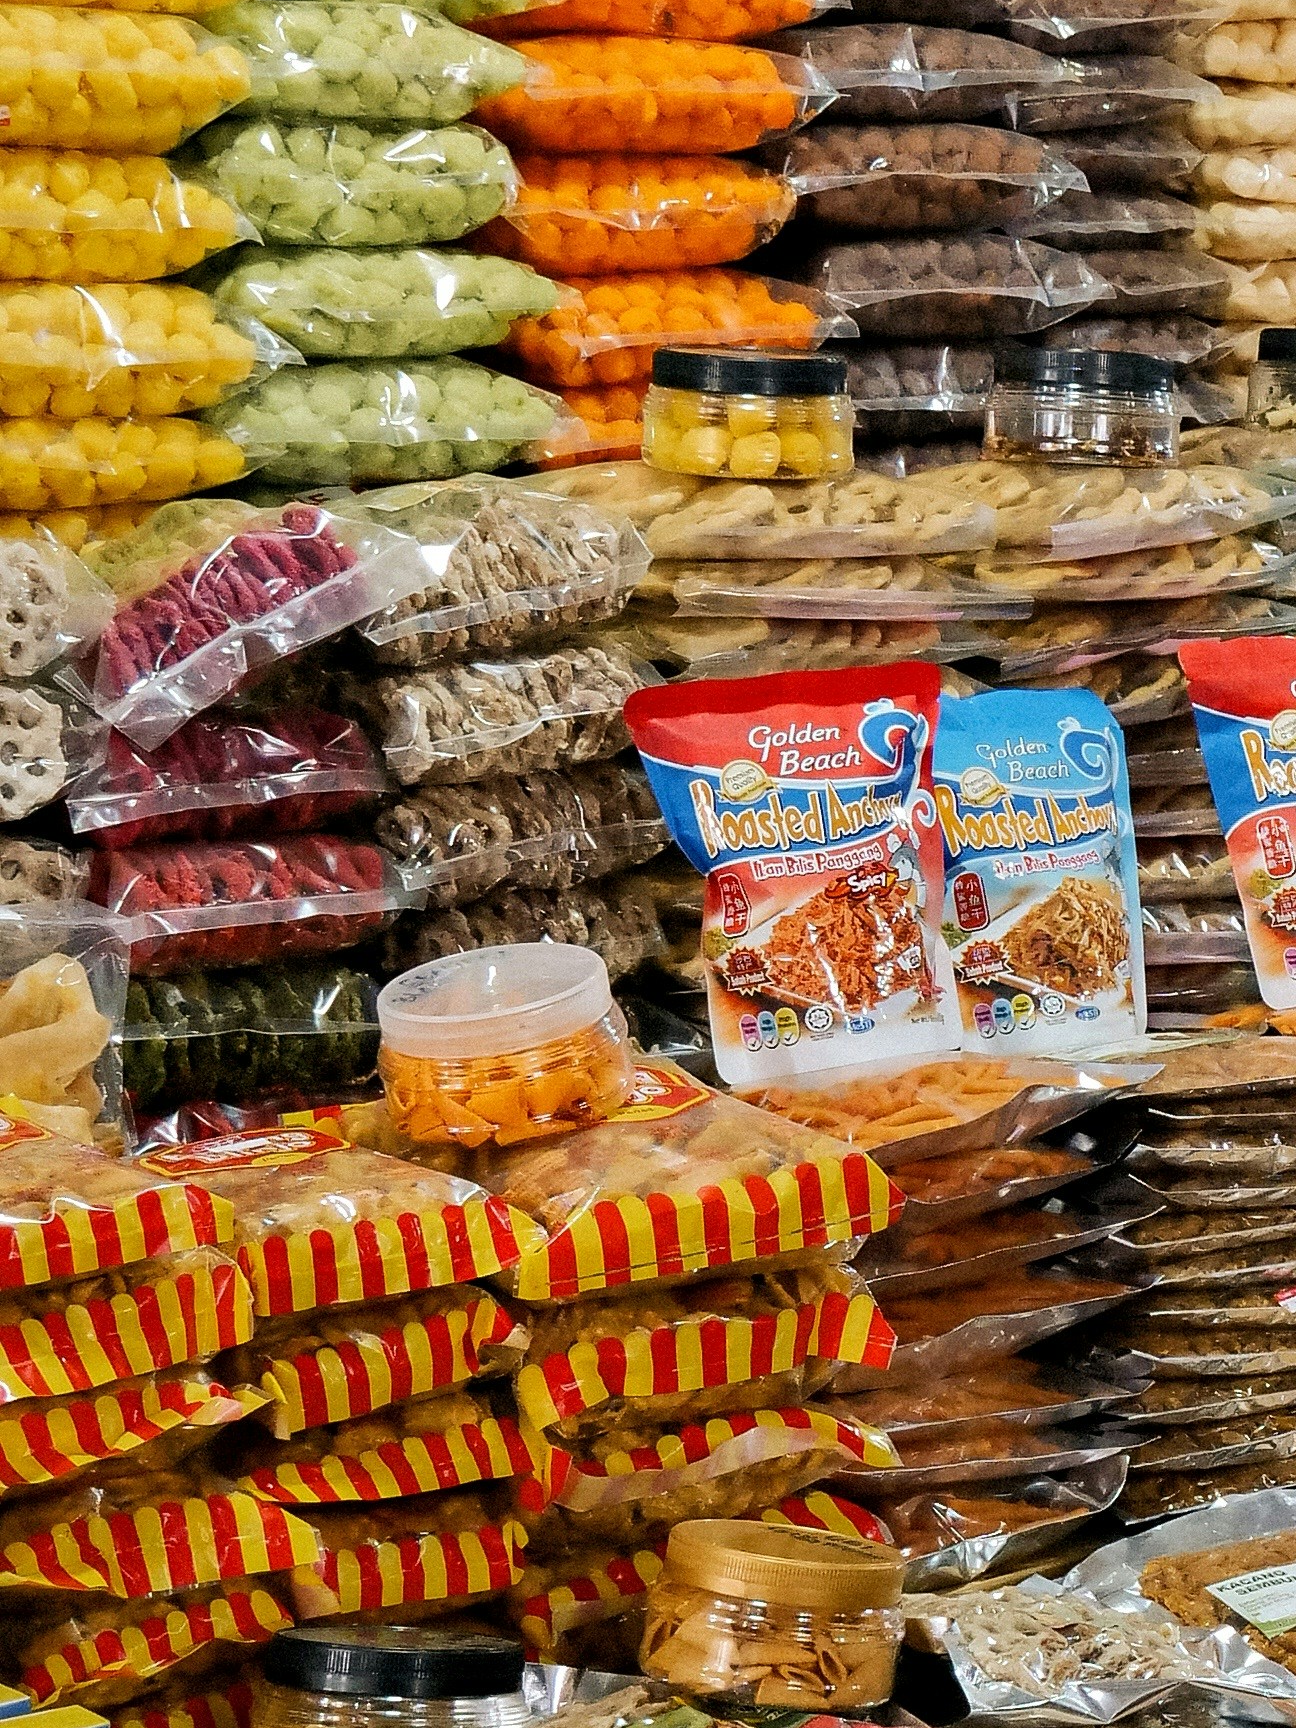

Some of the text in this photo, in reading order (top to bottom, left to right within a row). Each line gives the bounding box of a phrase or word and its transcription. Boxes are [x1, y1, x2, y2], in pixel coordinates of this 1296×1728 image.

[748, 723, 841, 762] Golden
[976, 735, 1049, 767] Golden
[780, 746, 862, 776] Beach
[1007, 760, 1071, 783] Beach
[691, 780, 826, 857] Roasted
[934, 784, 1052, 857] Roasted
[786, 856, 815, 875] Bilis
[816, 843, 883, 871] Panggang
[1024, 856, 1048, 874] Bilis
[1216, 1569, 1287, 1593] KACANG
